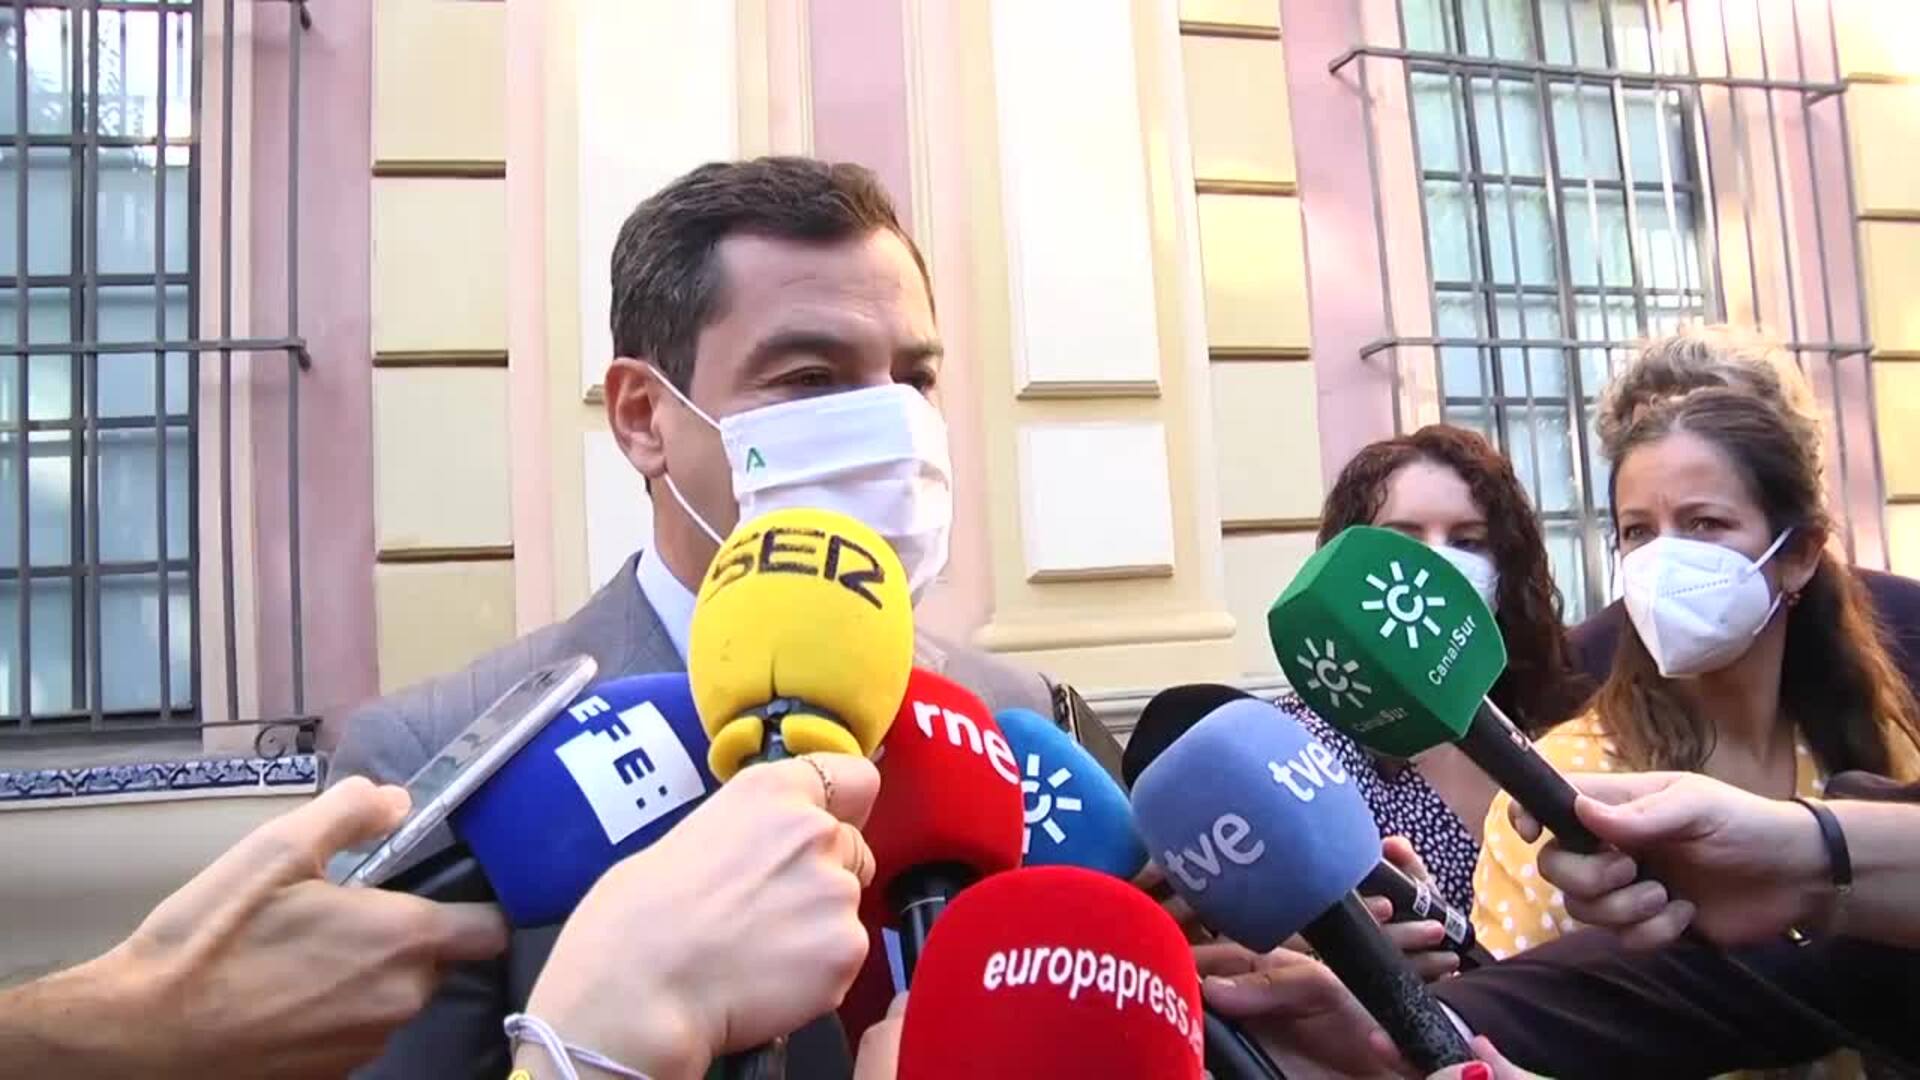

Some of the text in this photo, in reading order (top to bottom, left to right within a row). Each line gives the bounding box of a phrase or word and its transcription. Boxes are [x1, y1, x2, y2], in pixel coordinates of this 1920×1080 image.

[704, 526, 885, 610] SER
[1428, 615, 1478, 686] CanalSur
[912, 701, 1020, 785] rne
[1268, 741, 1347, 802] tve
[1163, 813, 1266, 892] tve
